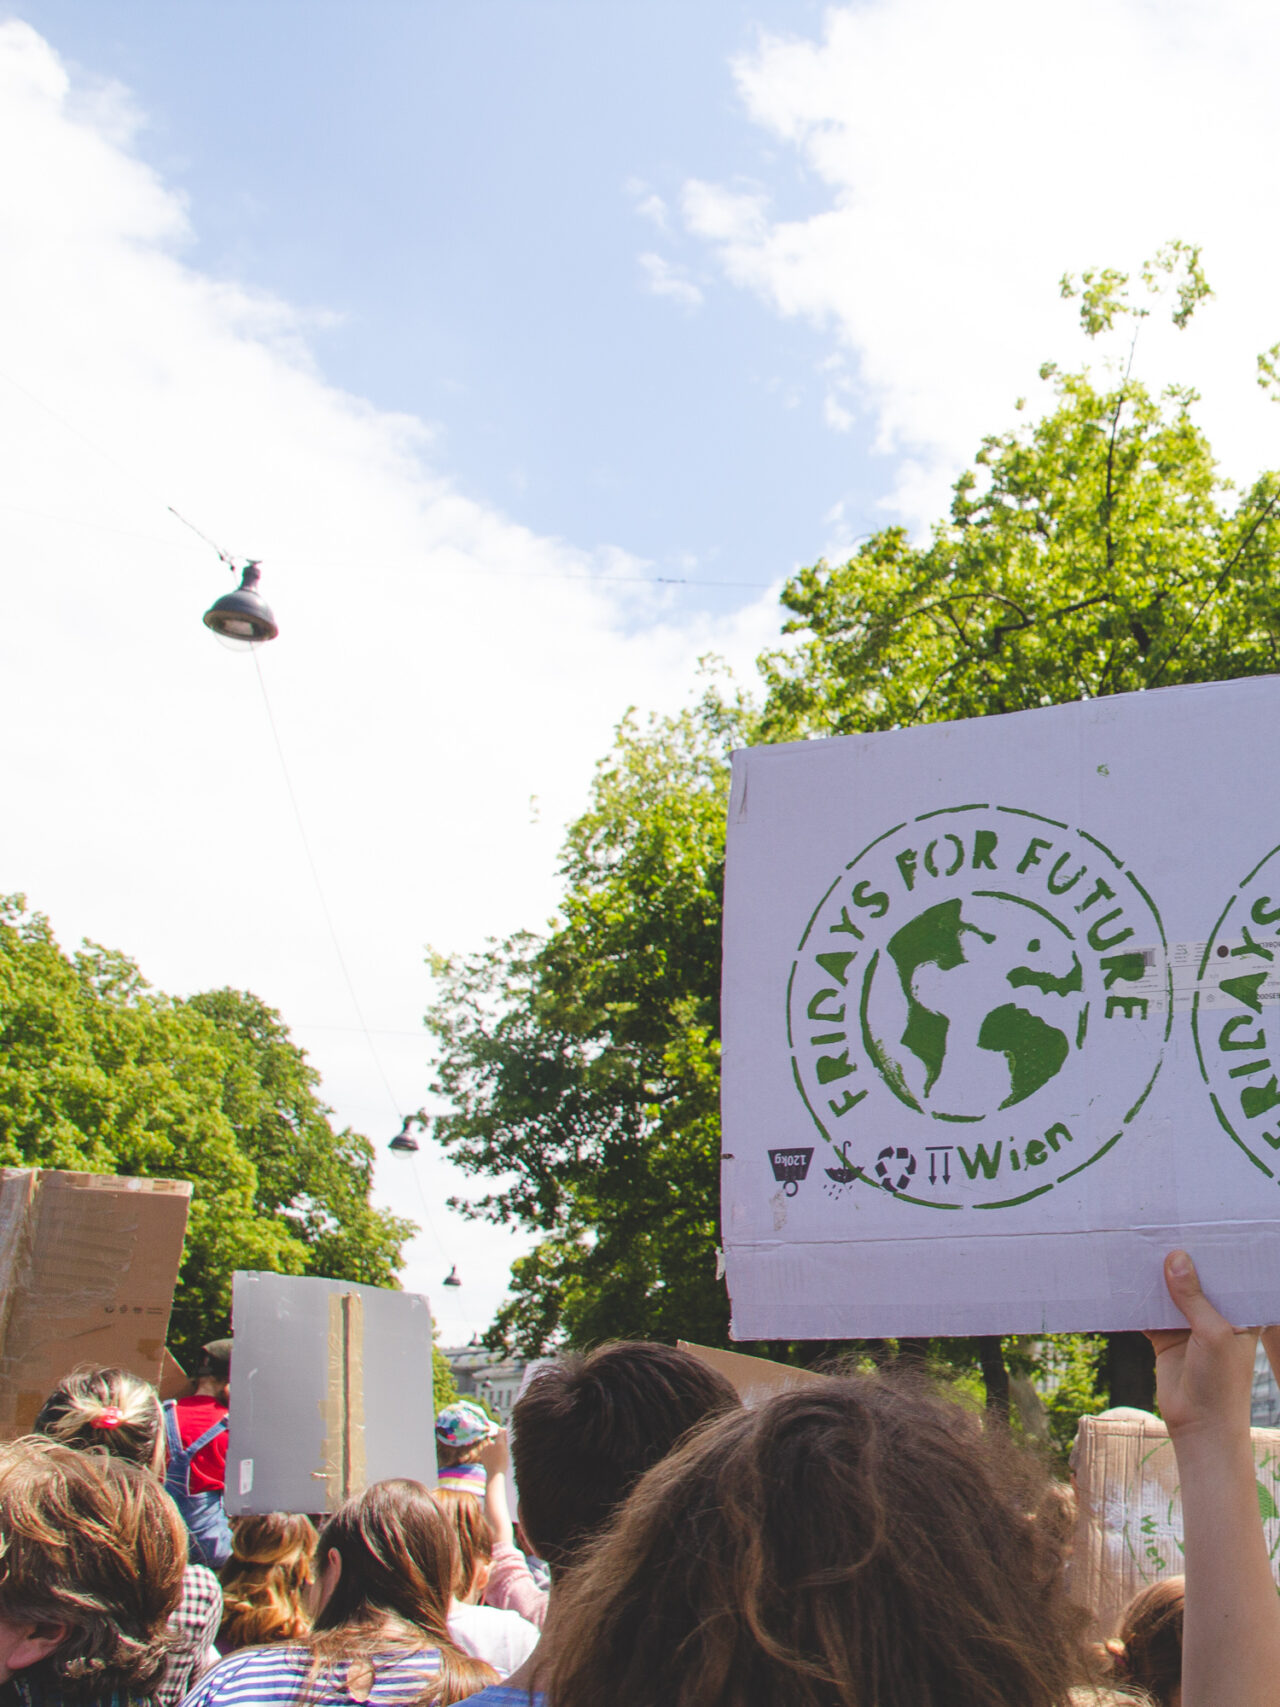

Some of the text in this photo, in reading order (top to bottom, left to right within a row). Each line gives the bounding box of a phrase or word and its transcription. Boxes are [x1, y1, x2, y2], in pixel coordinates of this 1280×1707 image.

[808, 830, 1150, 1119] FRIDAYS FOR FUTURE
[774, 1153, 807, 1167] 120kg
[957, 1121, 1074, 1180] Wien
[1141, 1513, 1167, 1572] Wien
